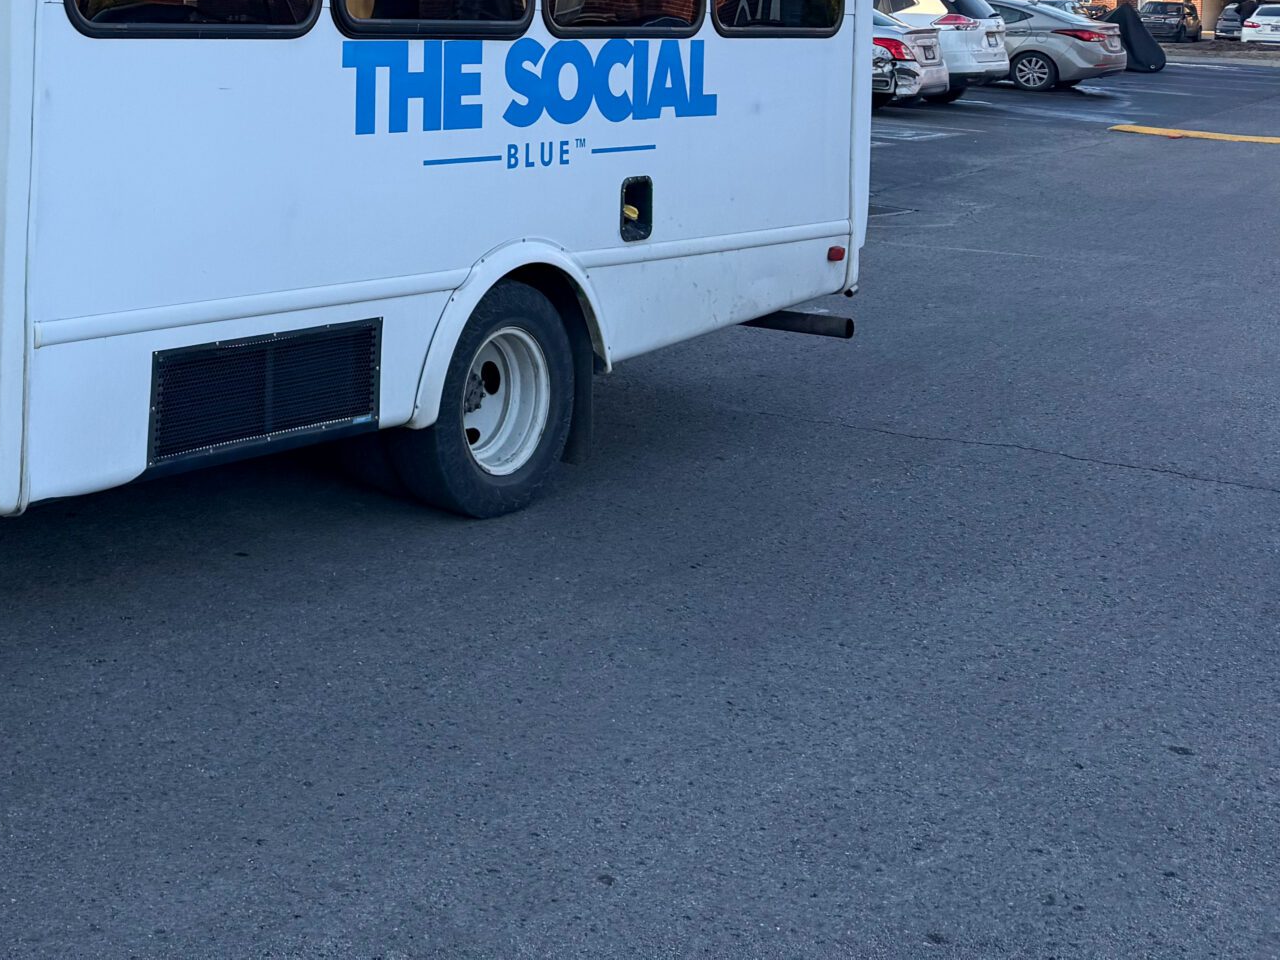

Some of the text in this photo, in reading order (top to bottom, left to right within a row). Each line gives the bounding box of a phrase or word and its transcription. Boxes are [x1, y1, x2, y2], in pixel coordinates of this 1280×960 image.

[342, 37, 718, 135] THE SOCIAL
[506, 140, 570, 169] BLUE
